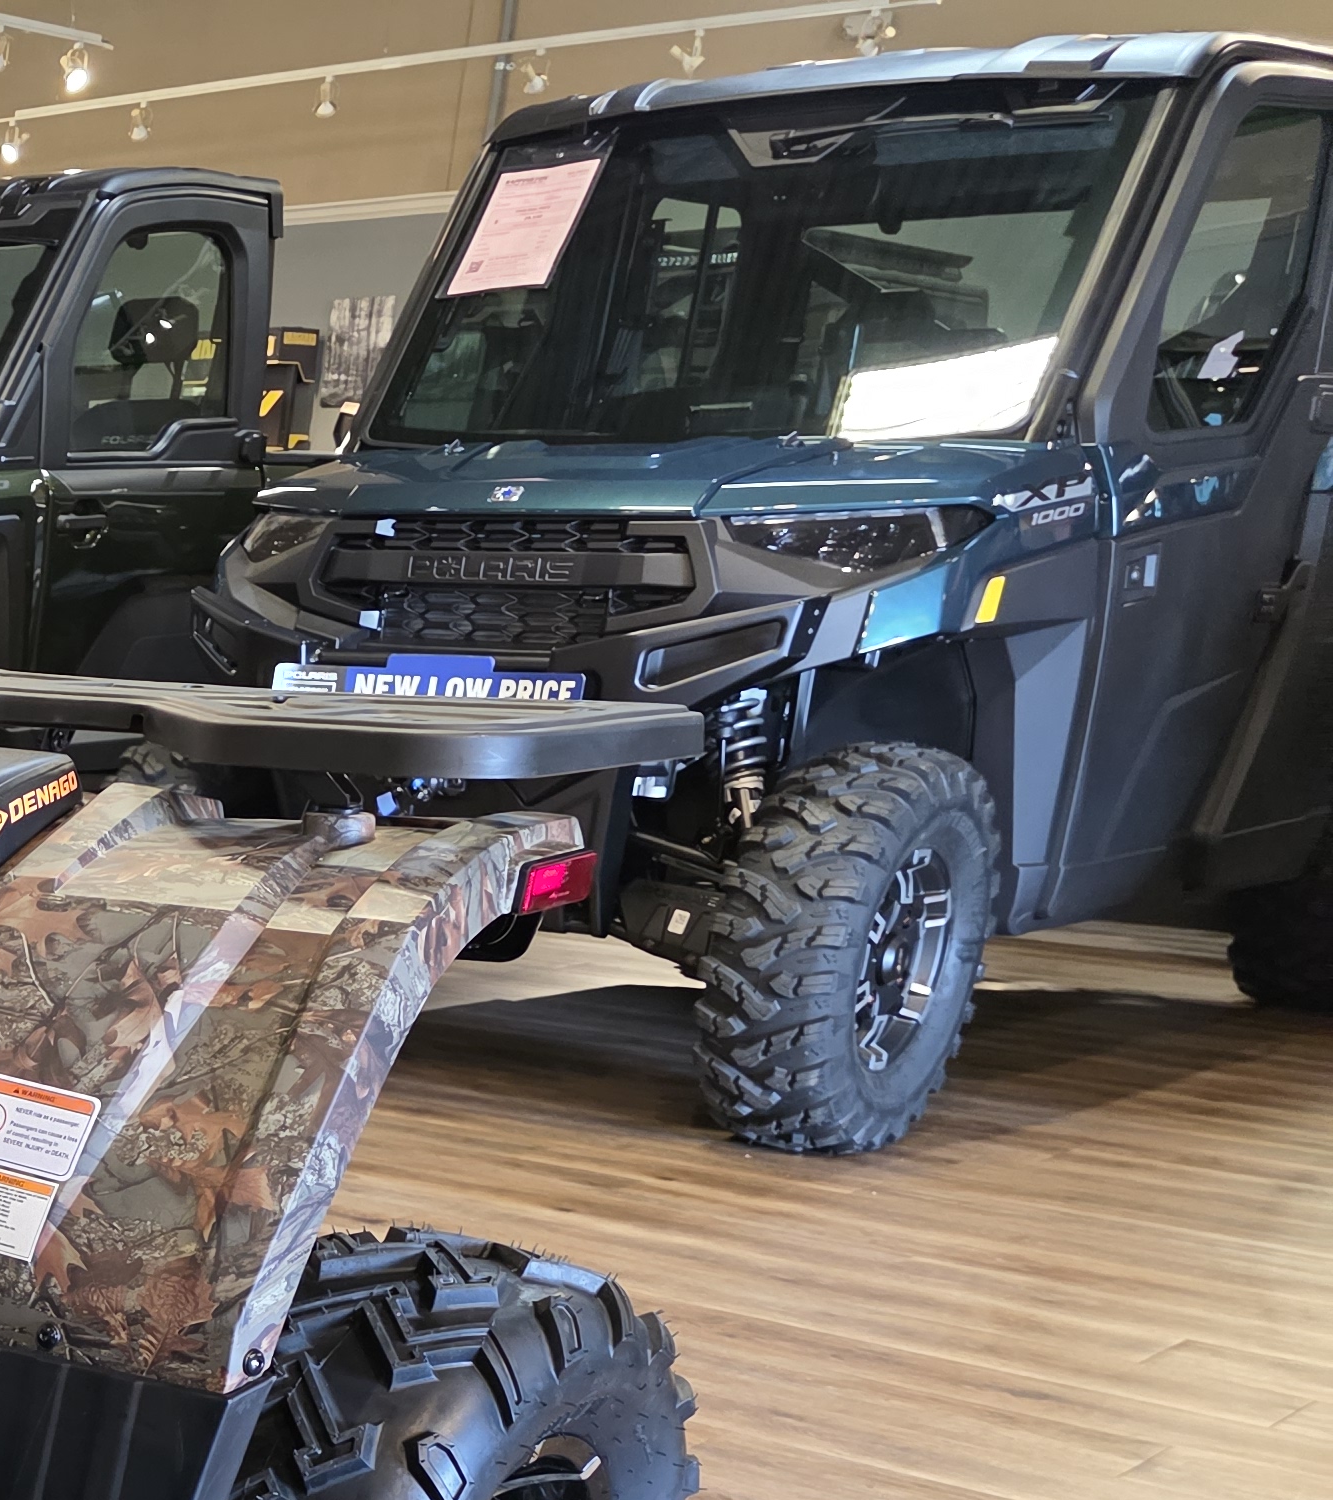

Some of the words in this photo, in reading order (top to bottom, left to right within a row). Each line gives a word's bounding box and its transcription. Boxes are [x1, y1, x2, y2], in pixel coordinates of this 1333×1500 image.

[1014, 471, 1089, 509] XP
[1031, 502, 1086, 526] 1000
[406, 555, 575, 582] POLARIS
[353, 672, 422, 697] NEW
[498, 678, 576, 701] PRICE
[8, 770, 78, 824] DENAGO
[20, 1089, 56, 1103] WARNING
[15, 1106, 34, 1116] NEVER
[9, 1120, 38, 1133] Passengers
[48, 1130, 63, 1139] cause
[67, 1134, 78, 1143] loss
[31, 1135, 53, 1147] resulting
[3, 1137, 23, 1148] SEVERE
[24, 1142, 45, 1153] INJURY
